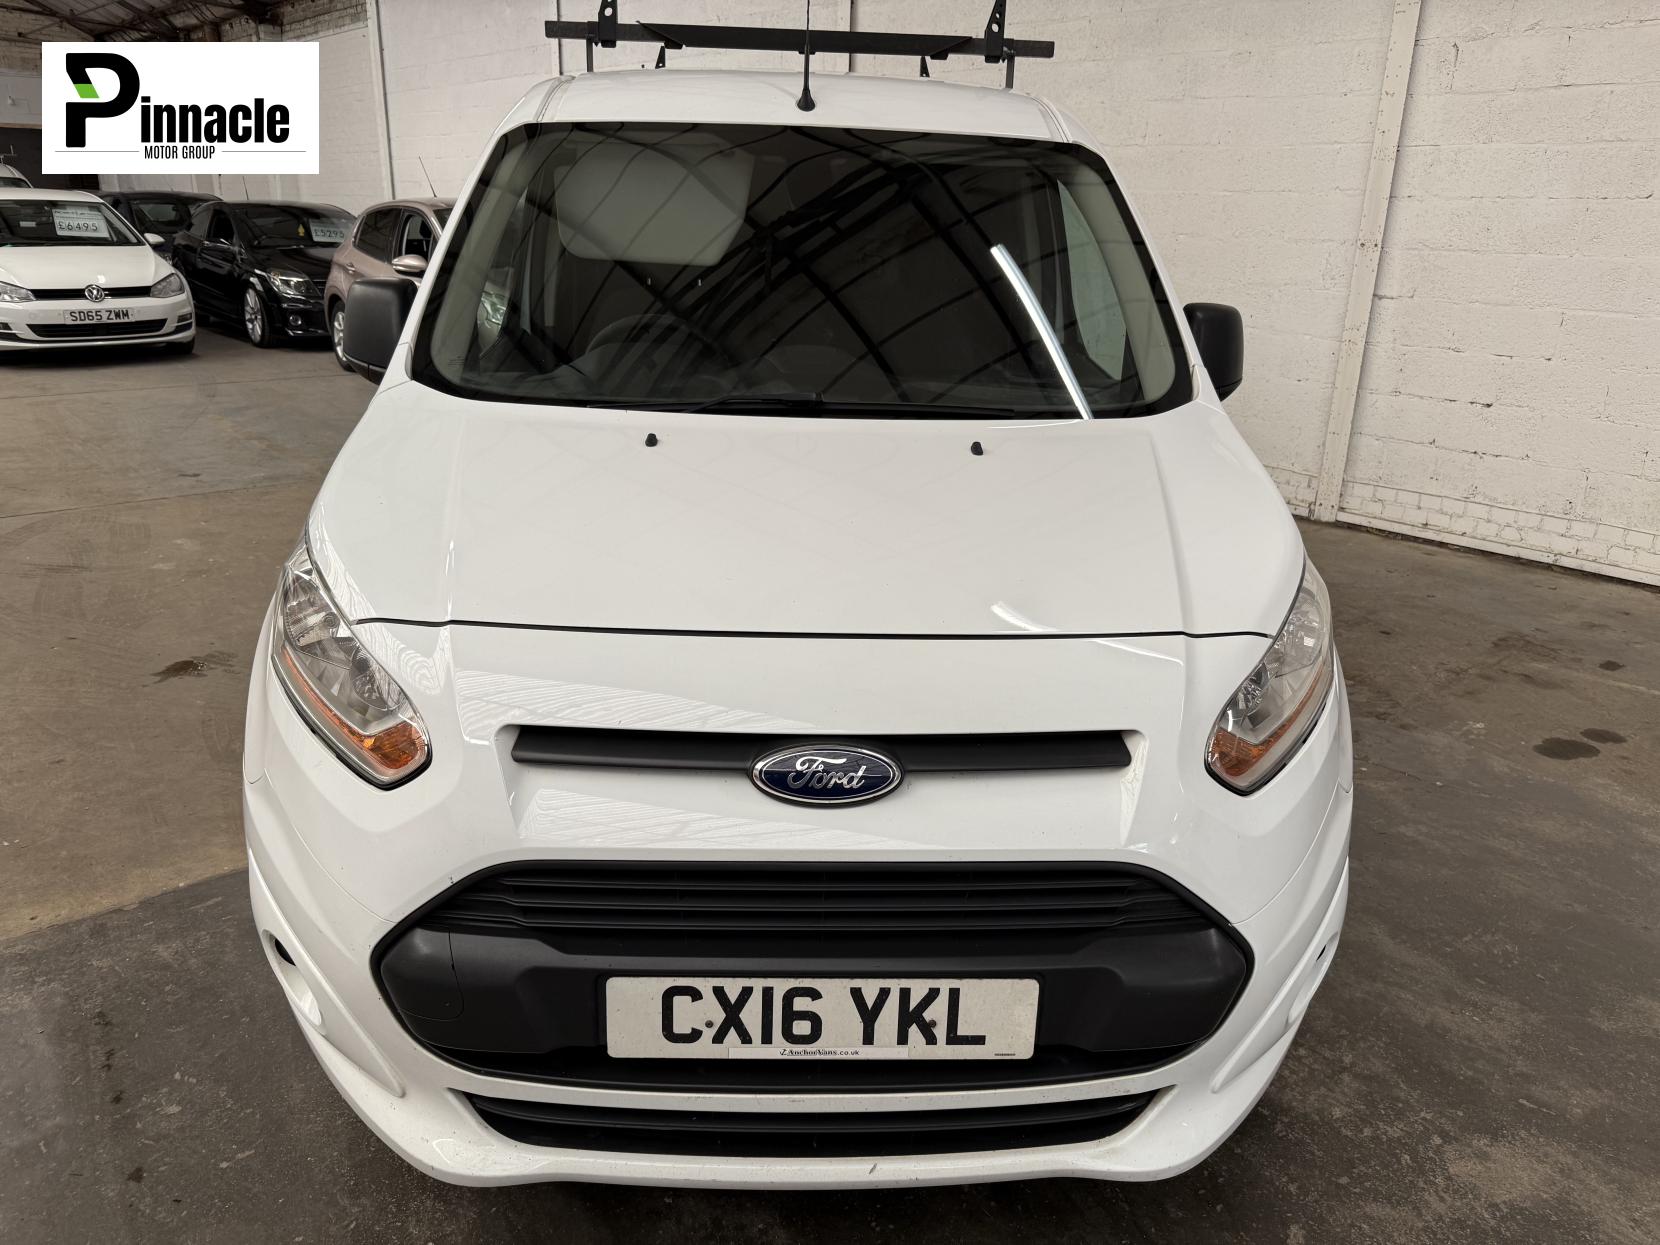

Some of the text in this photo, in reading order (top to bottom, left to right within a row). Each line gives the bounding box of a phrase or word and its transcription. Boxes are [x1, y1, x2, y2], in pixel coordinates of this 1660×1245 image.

[58, 221, 98, 232] £6495
[69, 309, 130, 322] SD65 ZWM
[786, 756, 867, 789] Ford
[661, 985, 987, 1046] CX16 YKL
